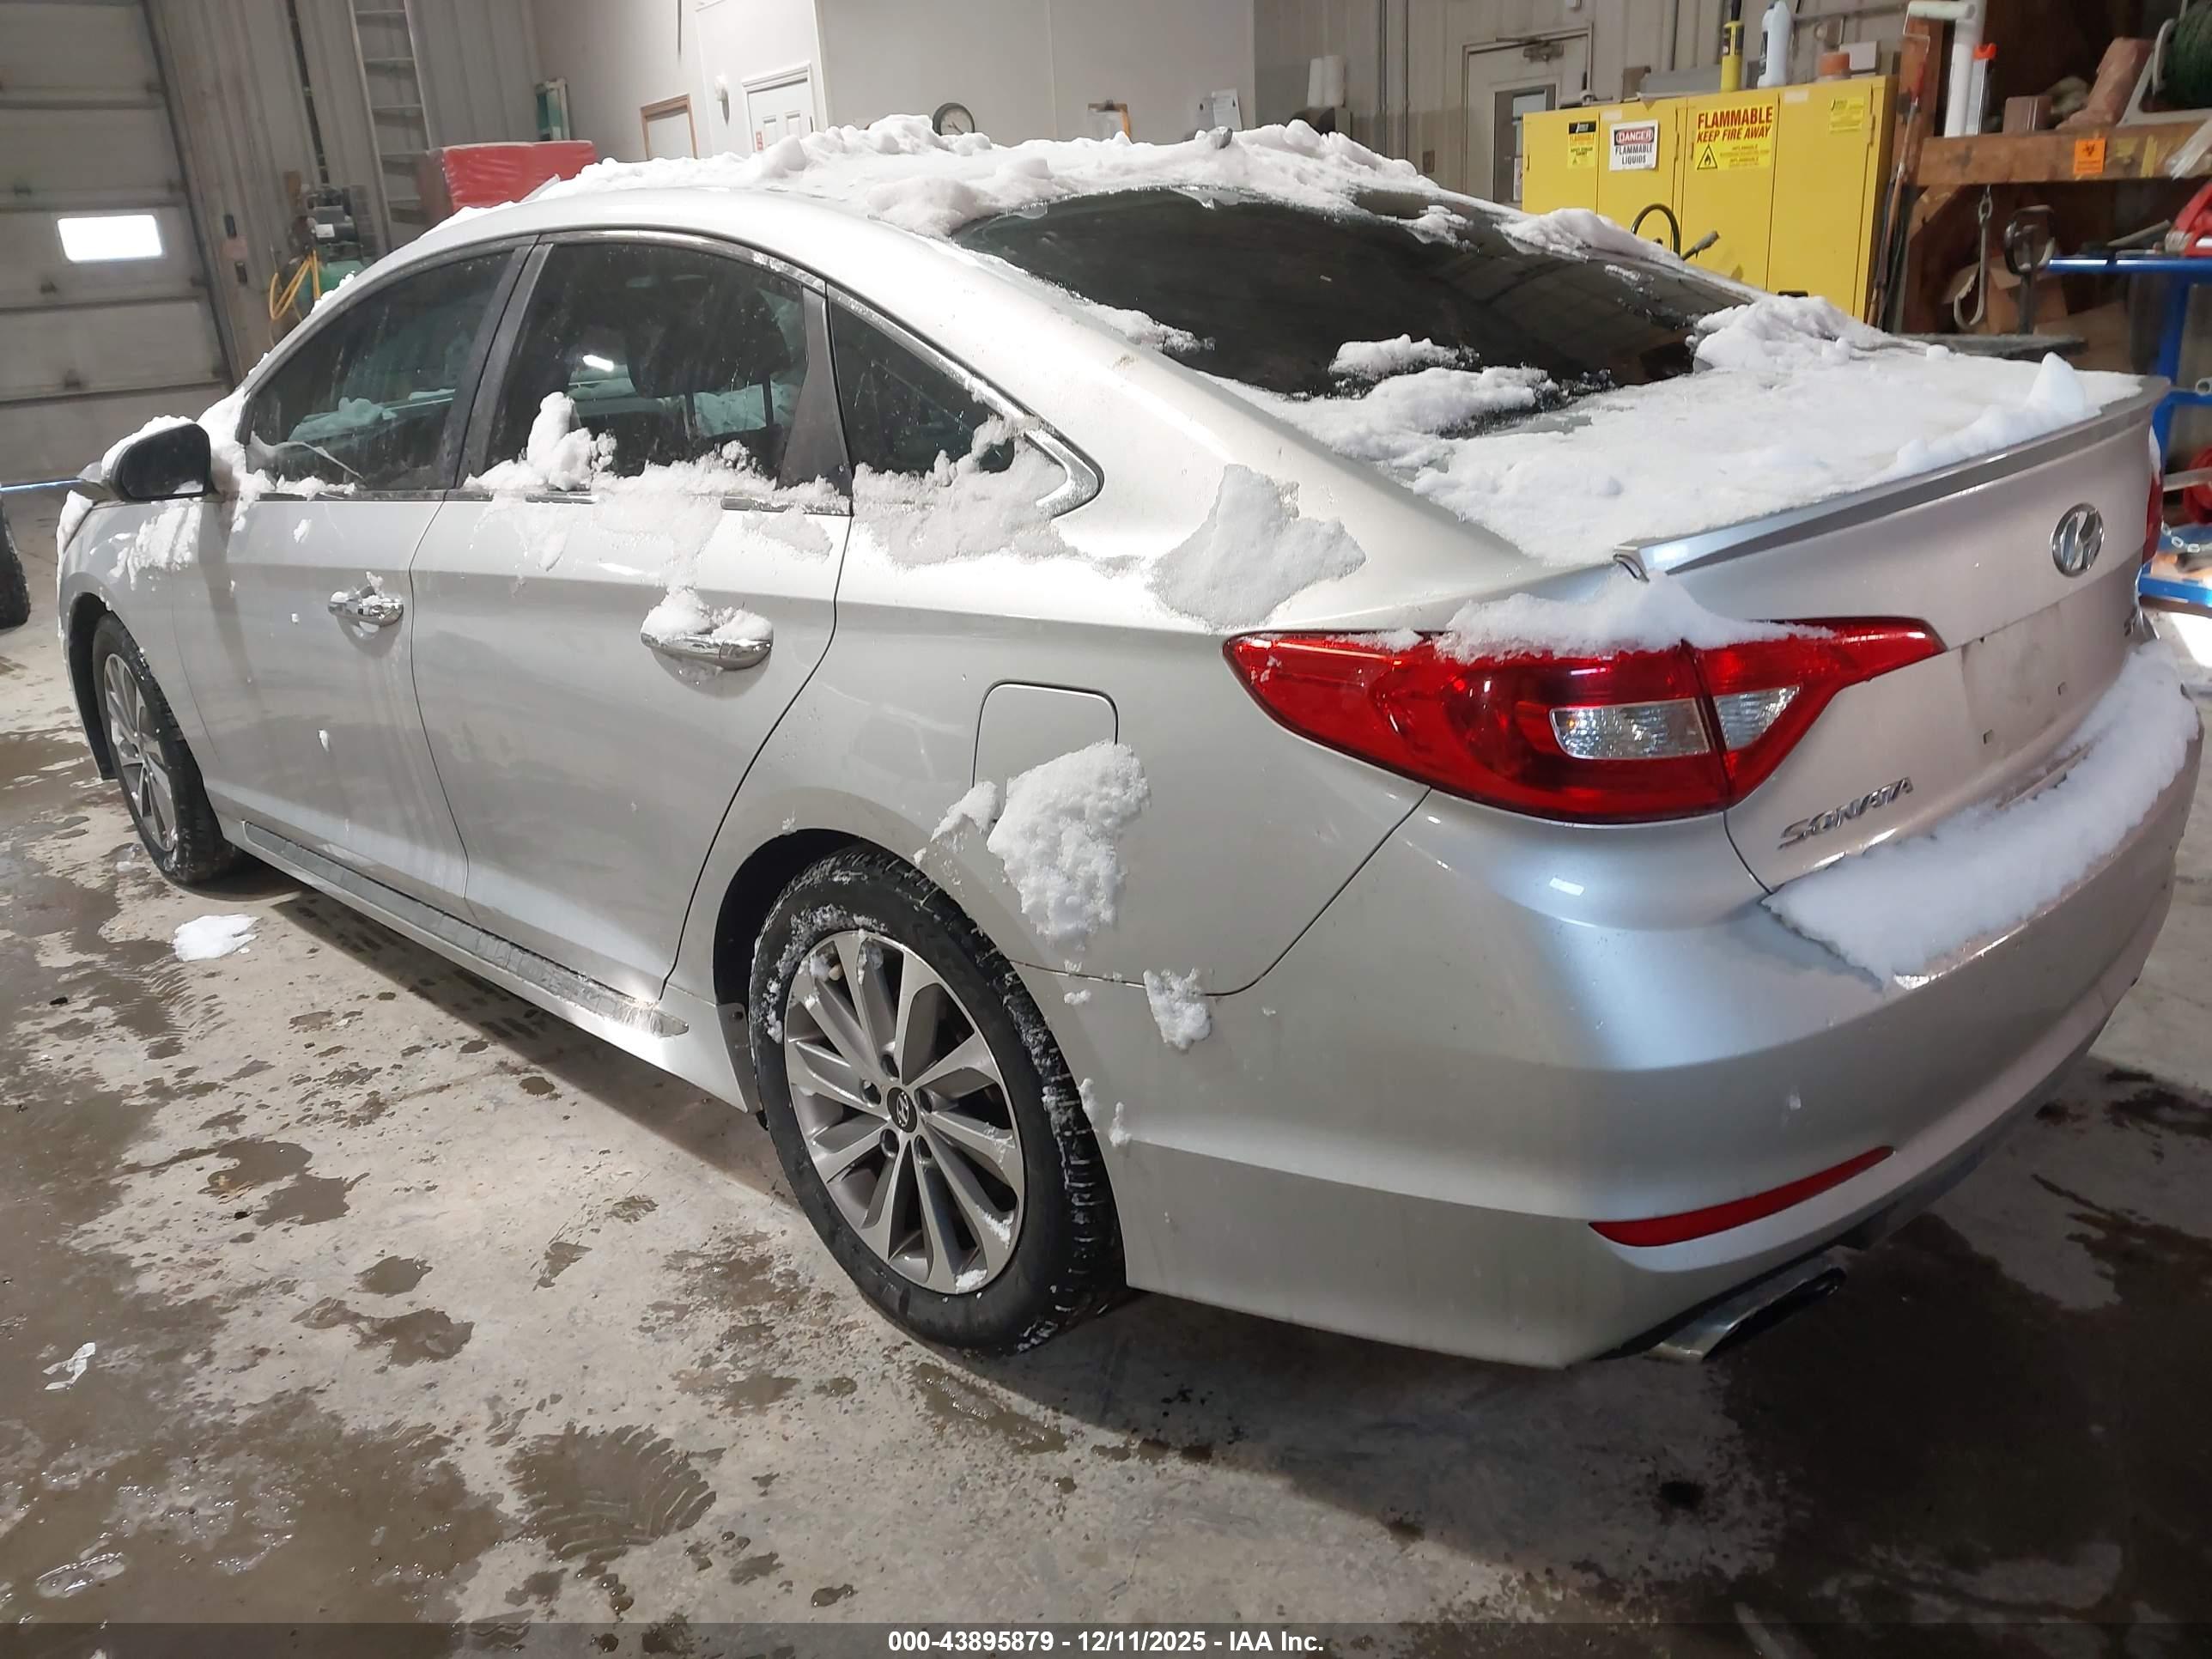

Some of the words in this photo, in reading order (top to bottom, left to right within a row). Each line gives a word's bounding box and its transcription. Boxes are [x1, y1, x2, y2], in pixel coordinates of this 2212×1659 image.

[1698, 106, 1773, 130] FLAMMABLE
[1619, 128, 1652, 143] DANGER
[1697, 130, 1720, 143] KEEP
[1722, 127, 1743, 142] FIRE
[1744, 124, 1771, 140] AWAY
[1615, 143, 1653, 155] FLAMMABLE
[1621, 154, 1647, 165] LIQUIDS
[1778, 775, 1914, 850] SONATA
